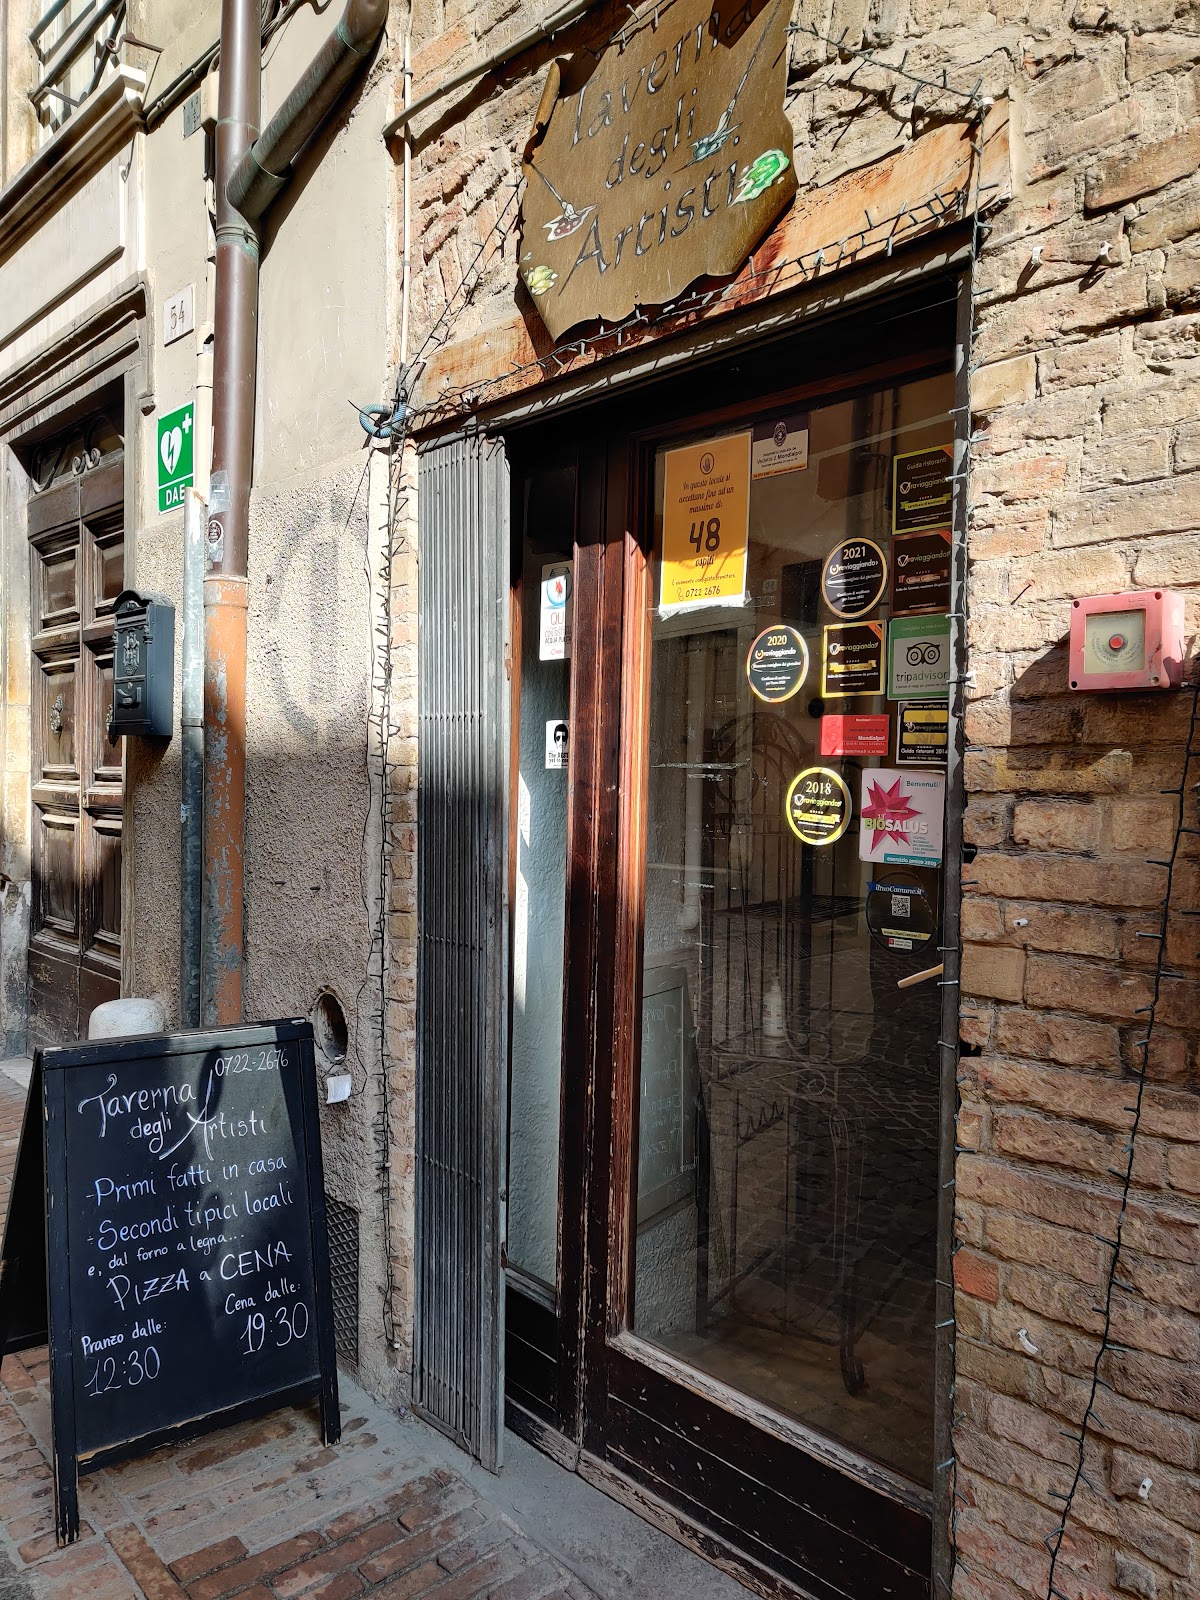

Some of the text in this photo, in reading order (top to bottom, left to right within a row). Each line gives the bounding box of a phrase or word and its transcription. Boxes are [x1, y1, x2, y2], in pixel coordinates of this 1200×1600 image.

[562, 0, 753, 151] Taverna
[605, 87, 699, 190] degli
[558, 135, 742, 298] Artisti
[170, 300, 186, 330] 54
[165, 483, 186, 506] DAE
[678, 493, 705, 504] accettano
[705, 490, 717, 501] fino
[718, 487, 726, 496] ad
[690, 479, 707, 491] questo
[709, 475, 725, 485] locale
[689, 503, 714, 514] massimo
[689, 517, 721, 554] 48
[695, 554, 715, 569] ospiti
[843, 546, 866, 560] 2021
[685, 585, 721, 598] 0722 2676
[767, 635, 788, 646] 2020
[896, 670, 949, 684] tripadvisor
[806, 780, 832, 795] 2018
[906, 780, 940, 788] Benvenuti!
[864, 817, 929, 835] BIOSALUS
[214, 1050, 289, 1077] 0722-2676
[77, 1073, 197, 1138] Taverna
[158, 1069, 267, 1161] Artisti
[130, 1112, 172, 1154] degli
[167, 1162, 212, 1192] fatti
[222, 1159, 239, 1180] in
[248, 1156, 288, 1176] casa
[184, 1193, 238, 1230] tipici
[244, 1180, 293, 1216] locali
[108, 1251, 128, 1270] dal
[136, 1246, 169, 1262] forno
[176, 1240, 187, 1251] a
[106, 1240, 293, 1312] PIZZA a CENA
[225, 1277, 302, 1315] Cena dalle:
[81, 1318, 168, 1356] Pranzo dalle:
[239, 1302, 309, 1355] 19:30
[84, 1346, 160, 1398] 12:30
